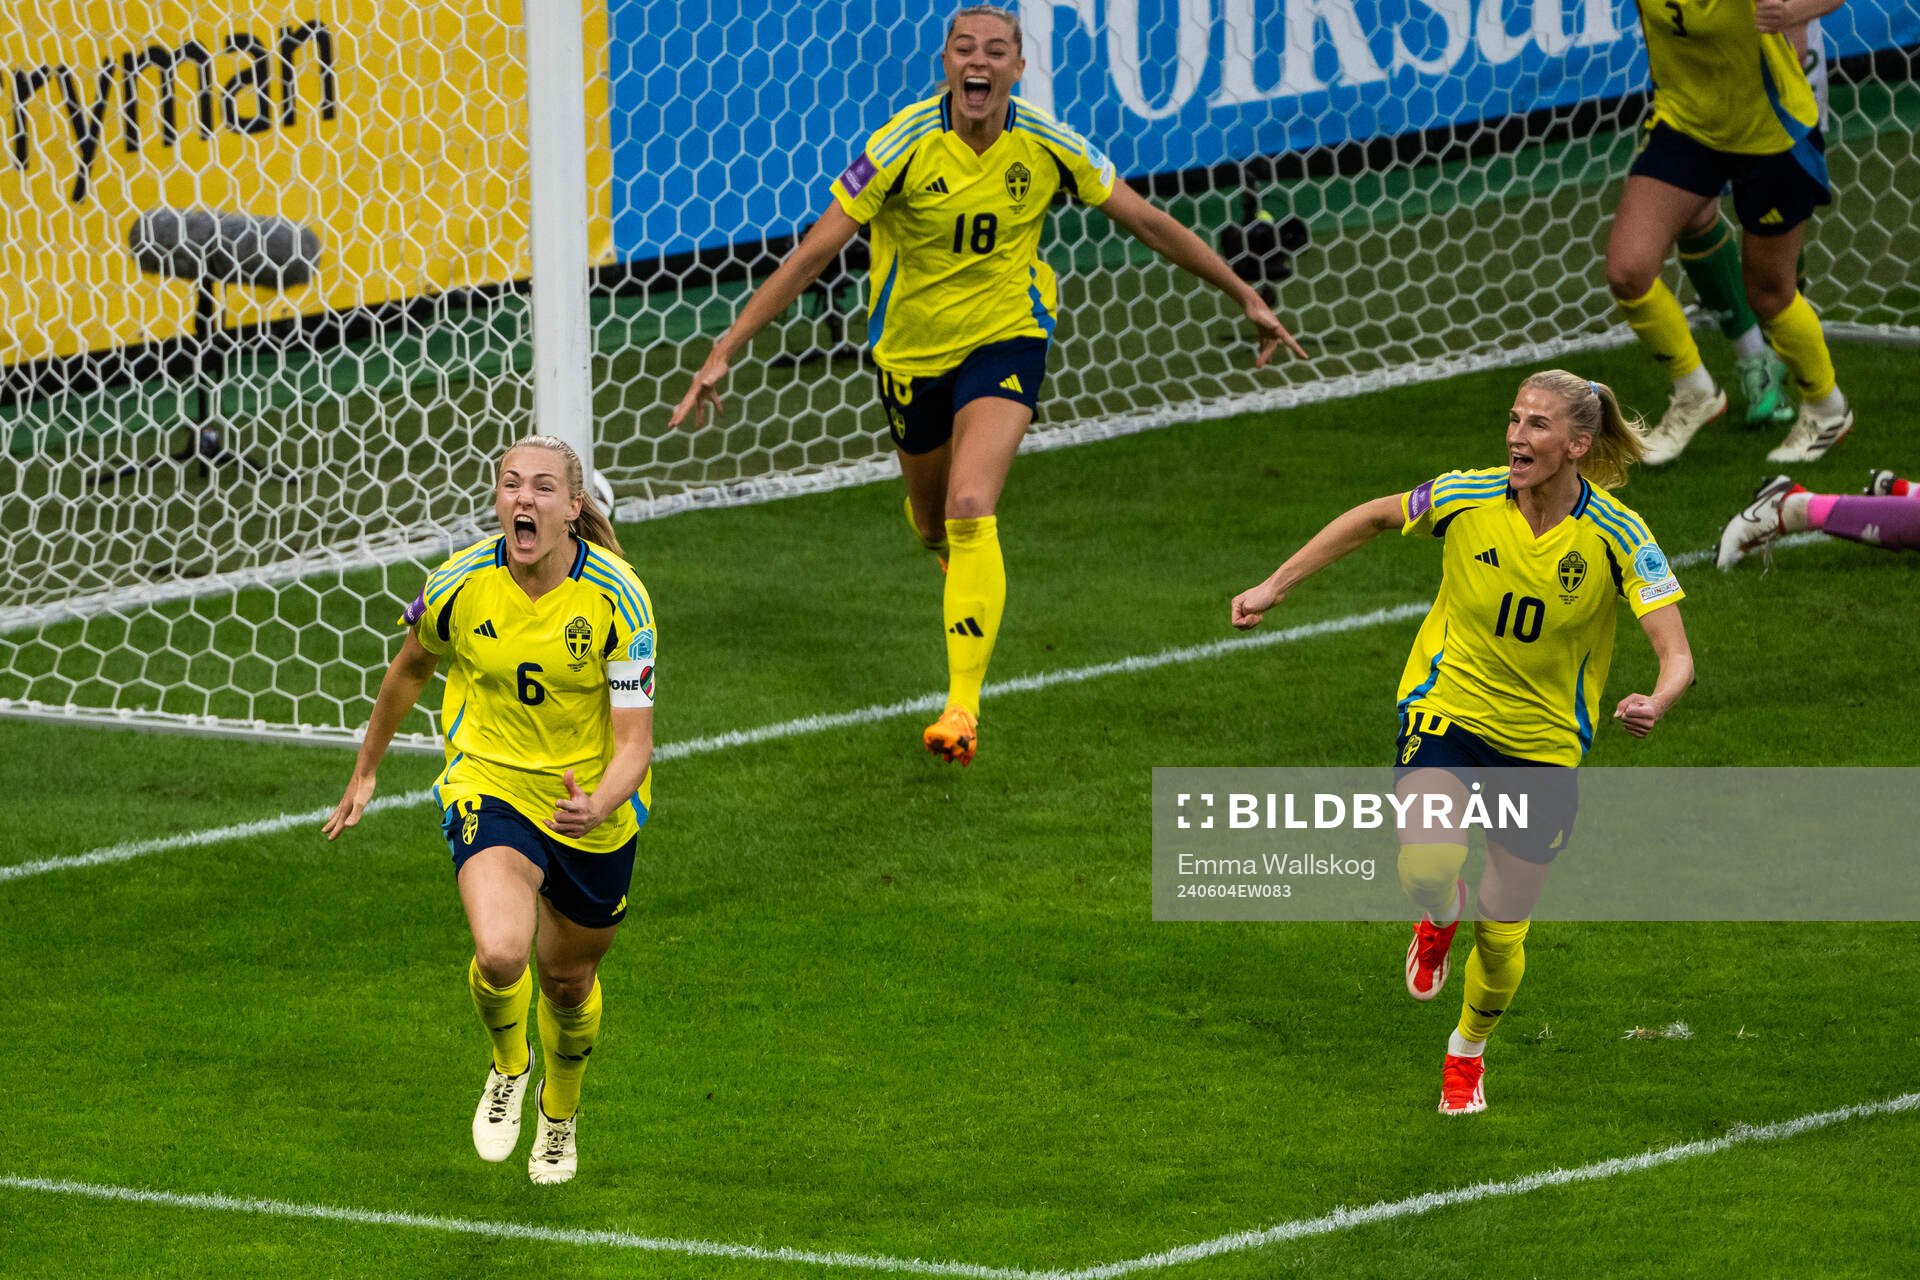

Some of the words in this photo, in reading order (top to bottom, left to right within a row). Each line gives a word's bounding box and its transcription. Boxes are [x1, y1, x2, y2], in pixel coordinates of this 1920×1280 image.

[0, 20, 335, 204] ryman
[953, 213, 998, 255] 18
[1494, 591, 1546, 643] 10
[516, 662, 545, 706] 6
[608, 678, 640, 691] ONE
